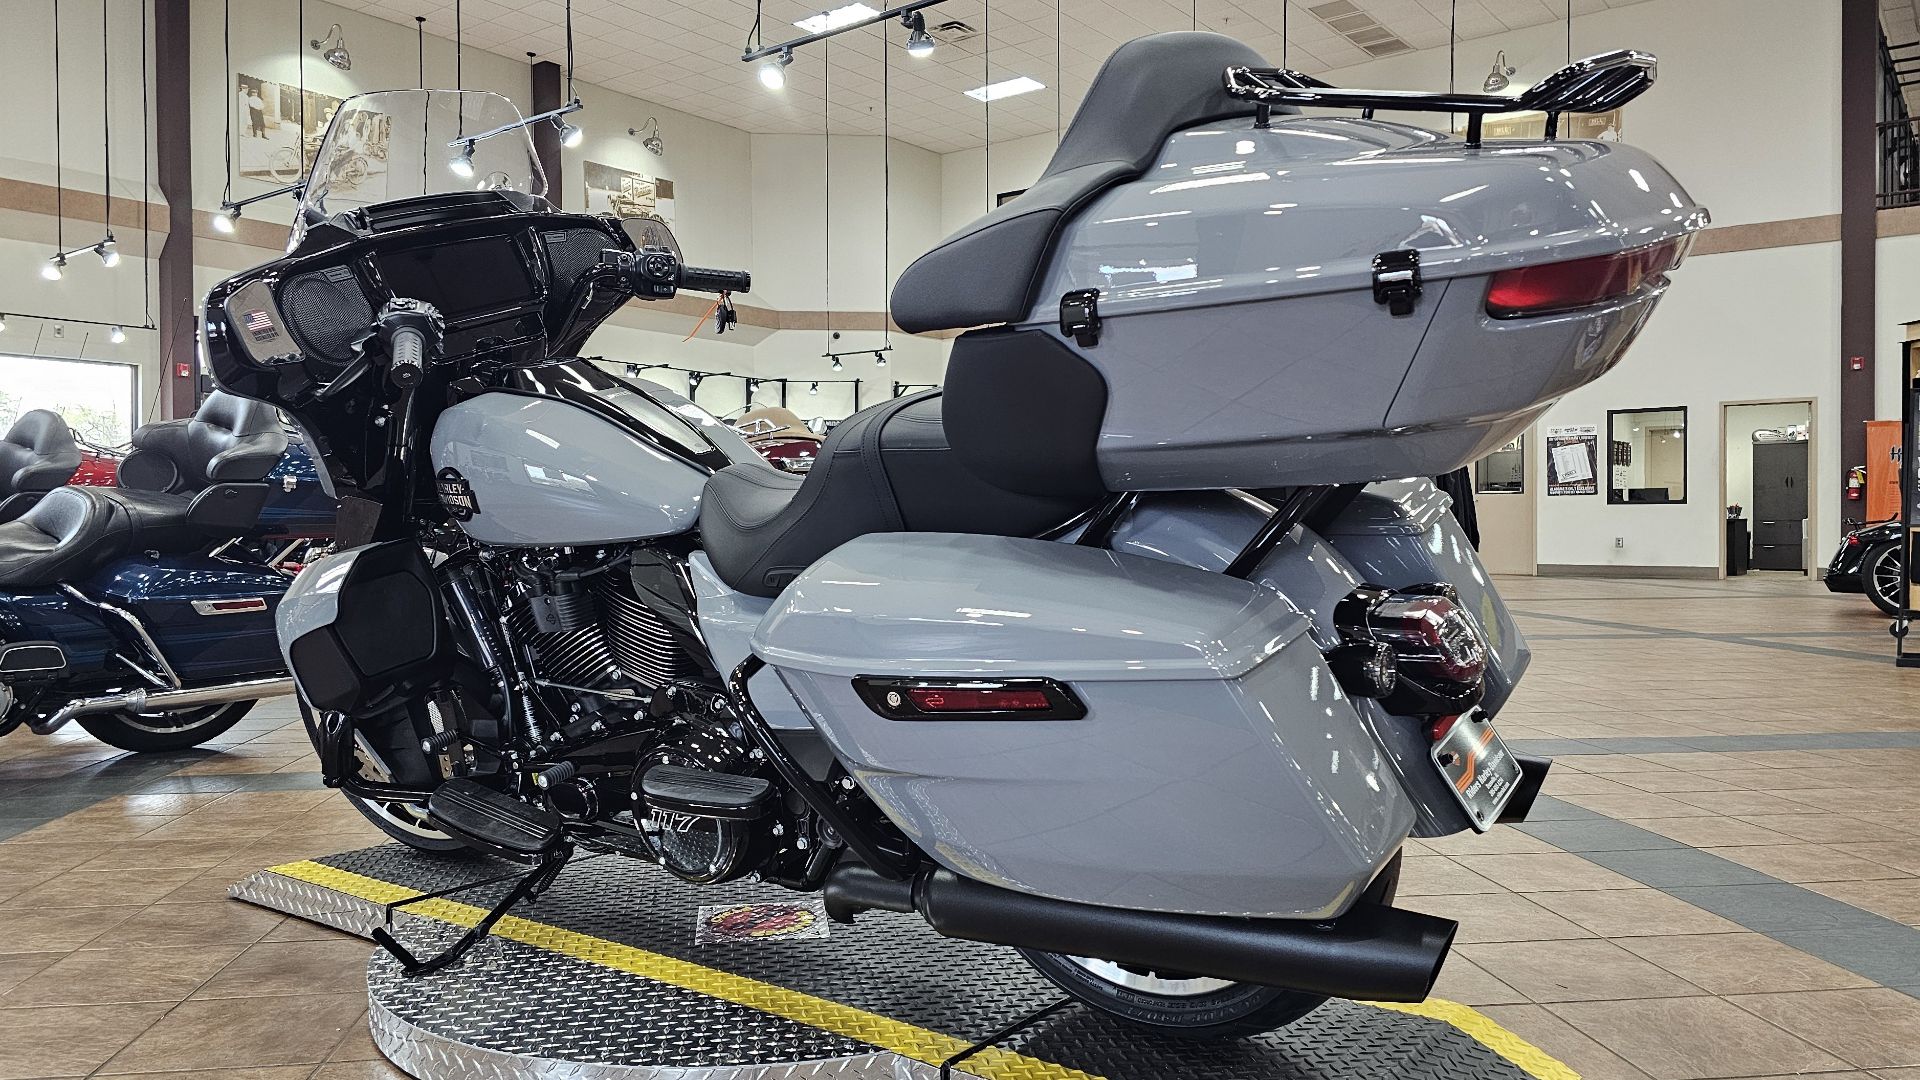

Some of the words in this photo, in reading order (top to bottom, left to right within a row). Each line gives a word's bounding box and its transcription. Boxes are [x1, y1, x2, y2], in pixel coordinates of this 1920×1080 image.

[1465, 780, 1482, 800] Riders
[1477, 749, 1505, 785] Harley-Davidson
[650, 808, 701, 832] 117
